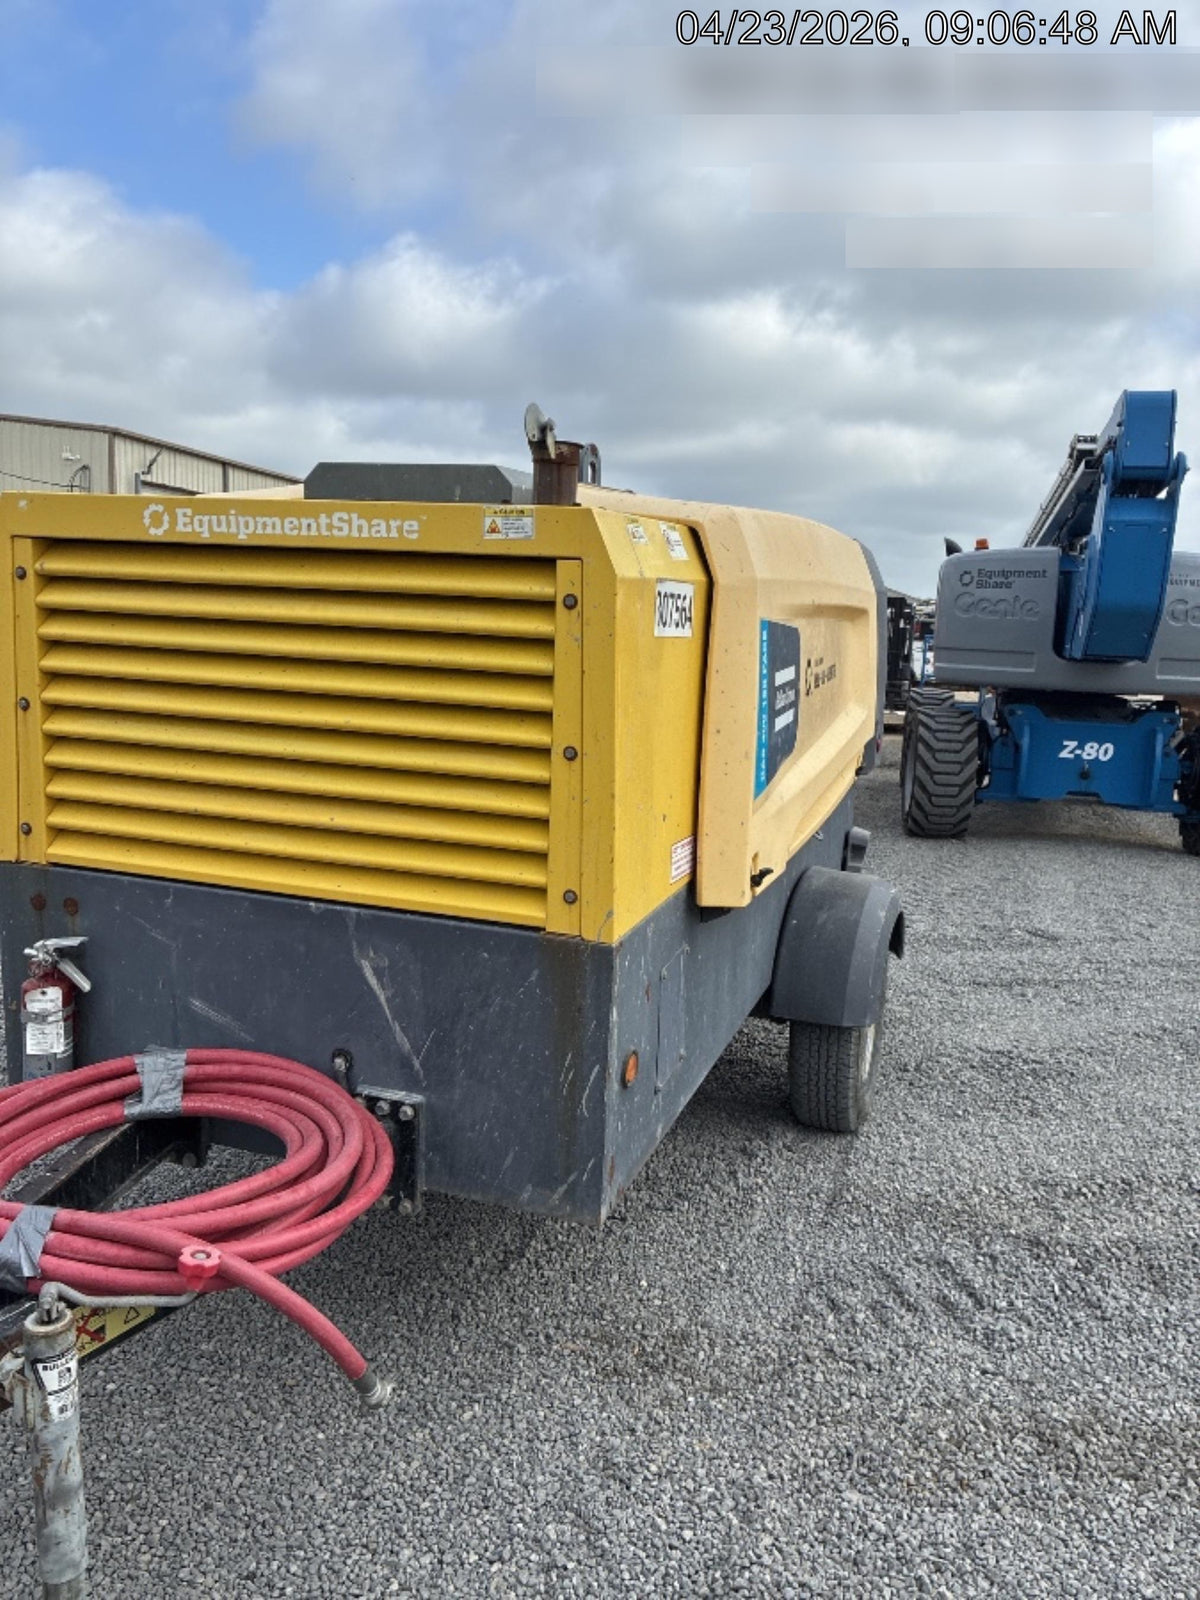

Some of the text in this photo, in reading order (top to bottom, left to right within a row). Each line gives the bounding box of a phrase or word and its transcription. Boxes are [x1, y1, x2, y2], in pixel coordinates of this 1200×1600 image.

[175, 508, 420, 539] EquipmentShare
[975, 579, 1013, 590] Share
[977, 568, 1048, 580] Equipment
[954, 591, 1040, 620] Genie
[1058, 740, 1115, 761] Z-80
